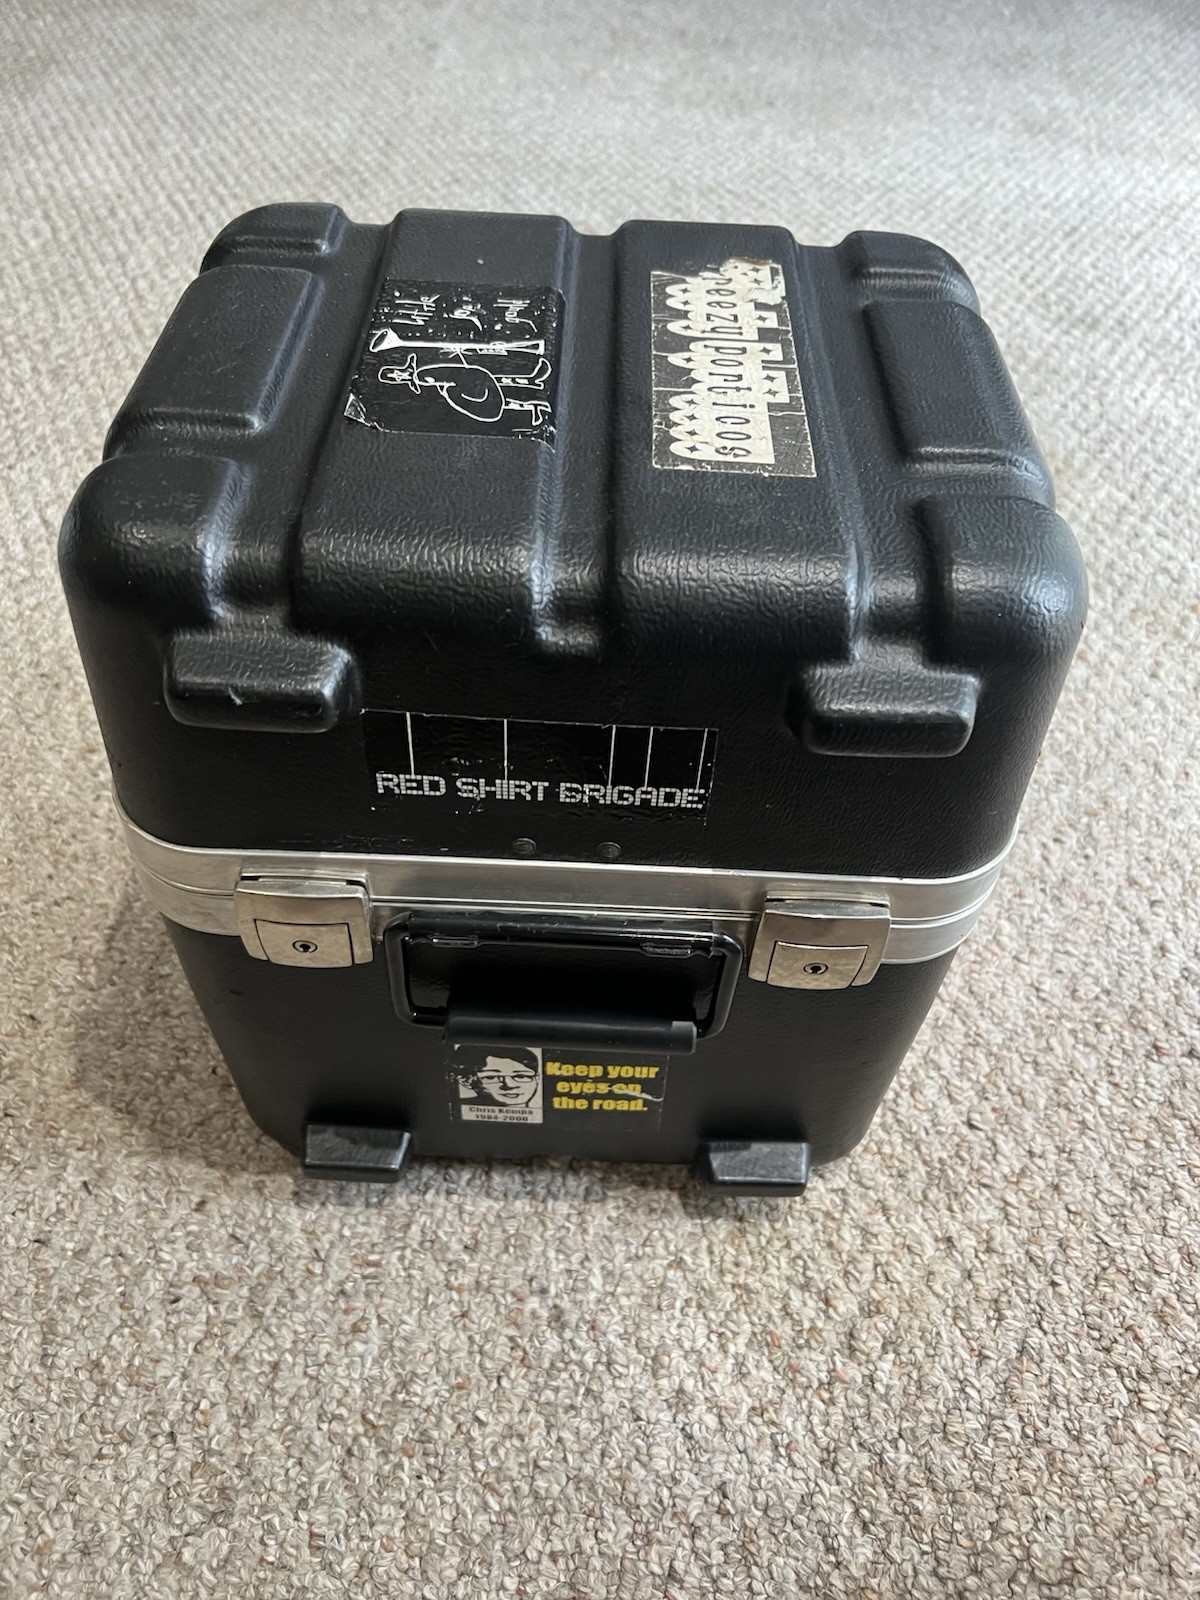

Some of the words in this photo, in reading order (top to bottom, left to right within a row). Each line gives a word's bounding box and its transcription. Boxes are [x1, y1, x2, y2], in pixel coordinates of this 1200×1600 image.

[701, 276, 743, 336] reezy
[703, 341, 756, 458] porticos
[376, 773, 447, 797] RED
[455, 777, 550, 802] SHIRT
[559, 782, 706, 809] BRIGADE
[546, 1061, 604, 1078] Keep
[607, 1065, 660, 1079] your
[556, 1080, 610, 1095] eyes
[611, 1082, 643, 1096] on
[469, 1106, 497, 1114] Chris
[498, 1107, 534, 1116] Kempa
[552, 1096, 589, 1110] the
[592, 1098, 649, 1112] road.
